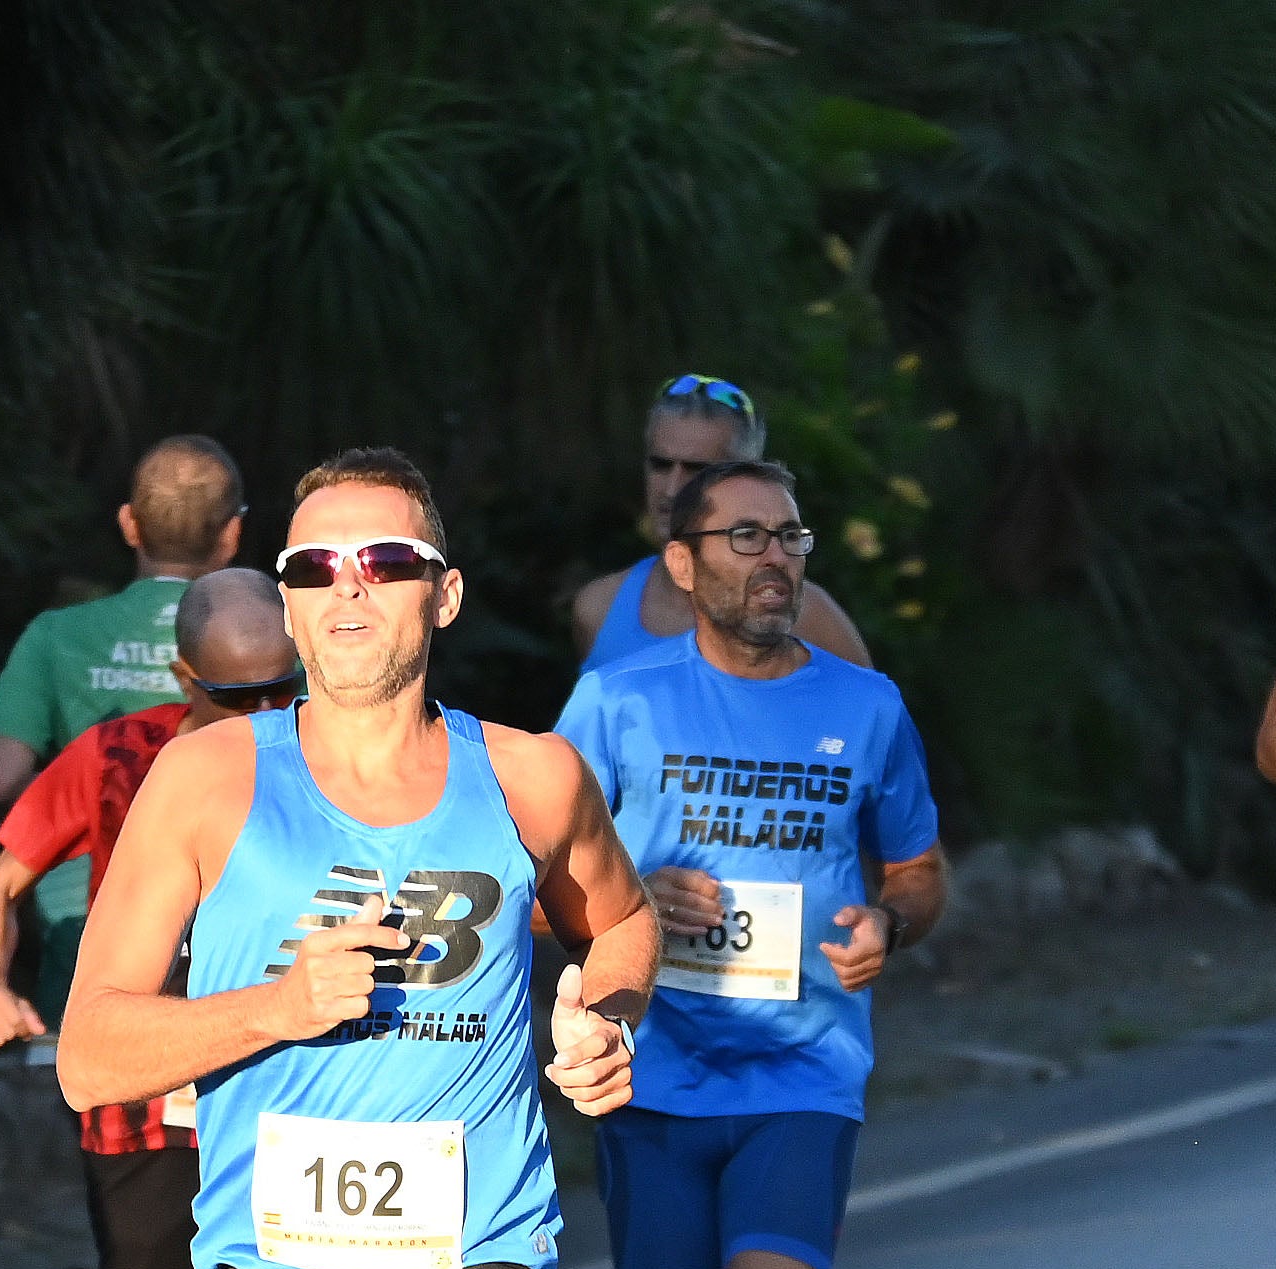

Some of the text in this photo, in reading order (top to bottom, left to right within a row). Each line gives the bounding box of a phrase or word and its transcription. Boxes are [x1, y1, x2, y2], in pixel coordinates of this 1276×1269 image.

[660, 754, 853, 806] FONDEROS
[679, 804, 826, 851] MALAGA
[398, 1011, 488, 1042] MALAGA
[304, 1157, 404, 1217] 162
